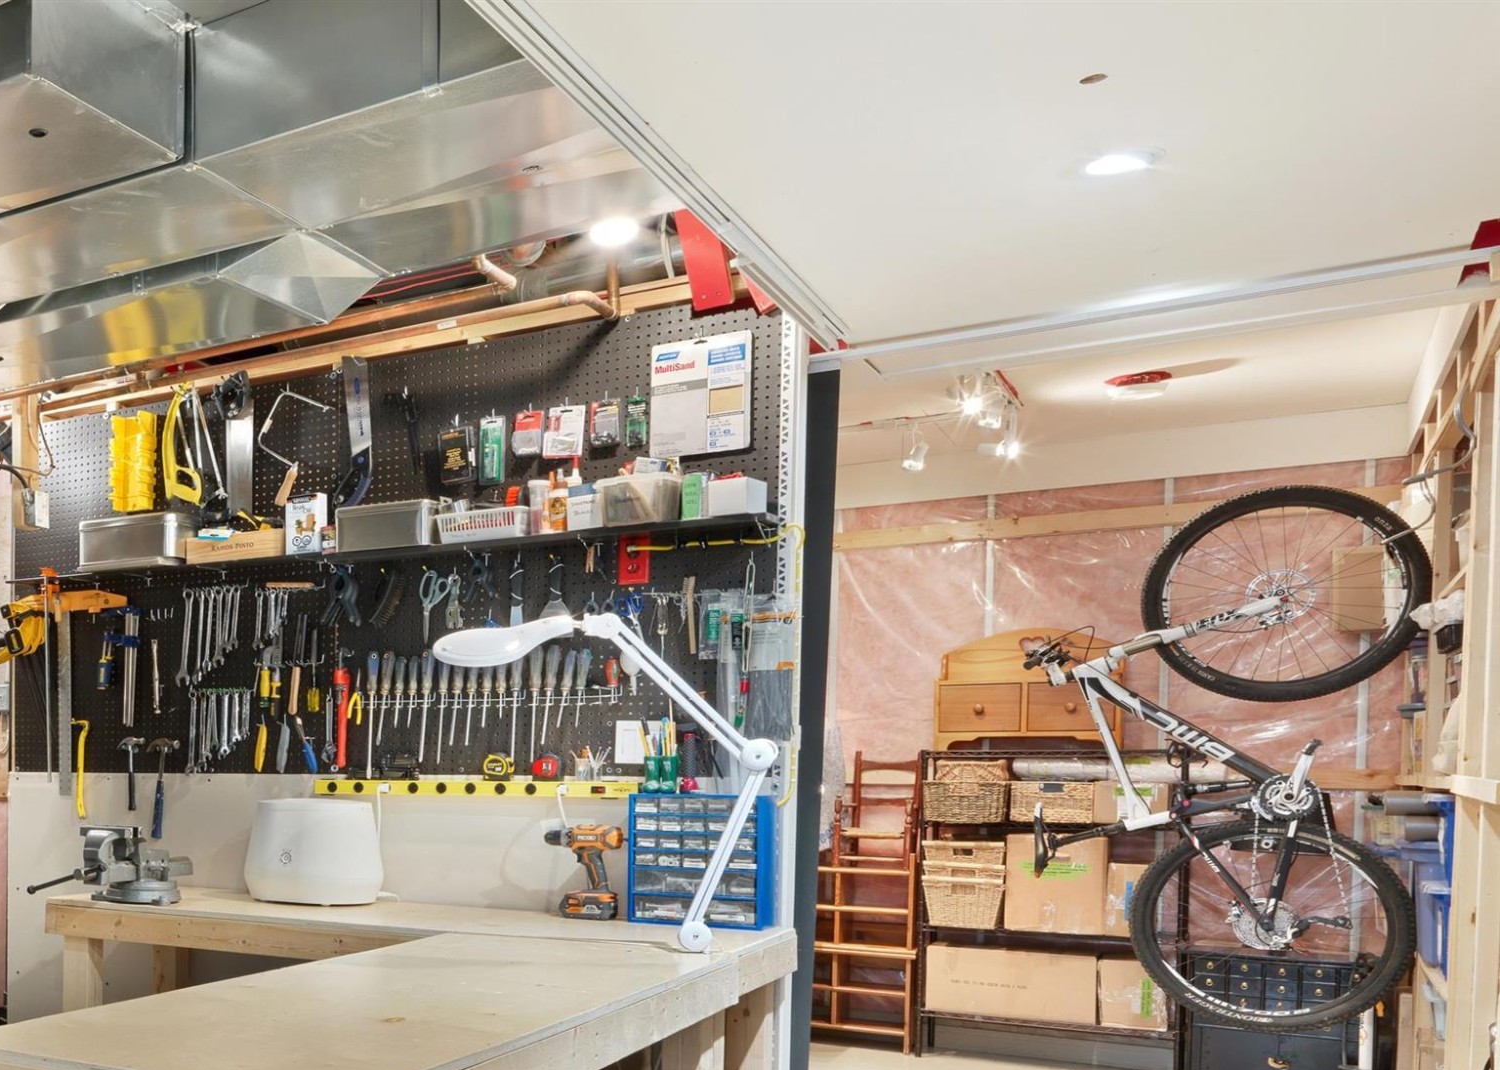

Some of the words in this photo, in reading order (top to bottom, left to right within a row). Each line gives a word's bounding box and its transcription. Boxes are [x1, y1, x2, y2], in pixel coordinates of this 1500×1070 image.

[654, 360, 696, 375] MultiSand
[211, 543, 234, 552] RAMOS
[234, 541, 255, 549] PINTO
[1145, 711, 1237, 763] BMC
[1184, 991, 1268, 1023] BONTRAGER
